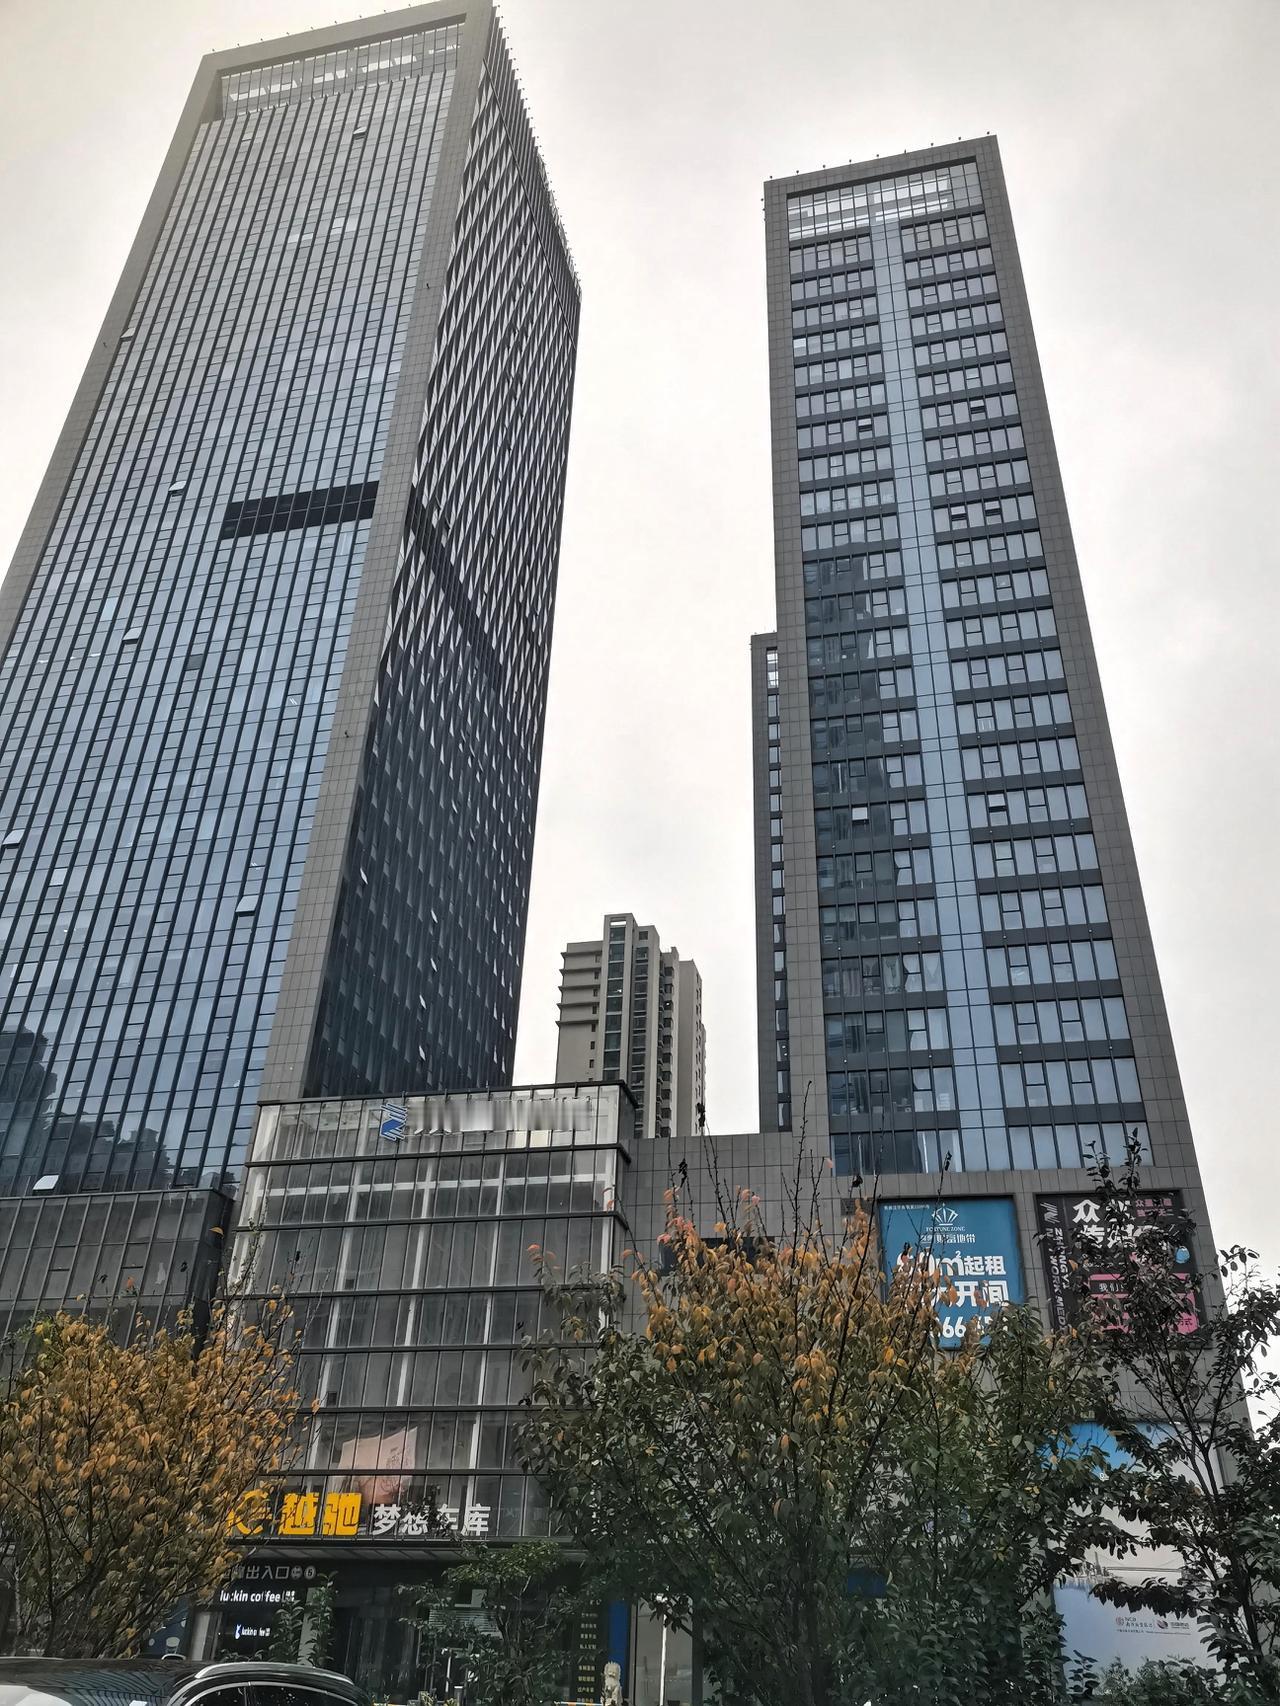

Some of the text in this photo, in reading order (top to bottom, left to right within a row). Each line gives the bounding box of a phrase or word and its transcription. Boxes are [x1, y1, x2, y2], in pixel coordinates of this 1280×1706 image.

[905, 1280, 1010, 1308] 大开间
[278, 1492, 362, 1536] 越驰
[225, 1565, 290, 1581] 出入口
[250, 1590, 280, 1602] cofee
